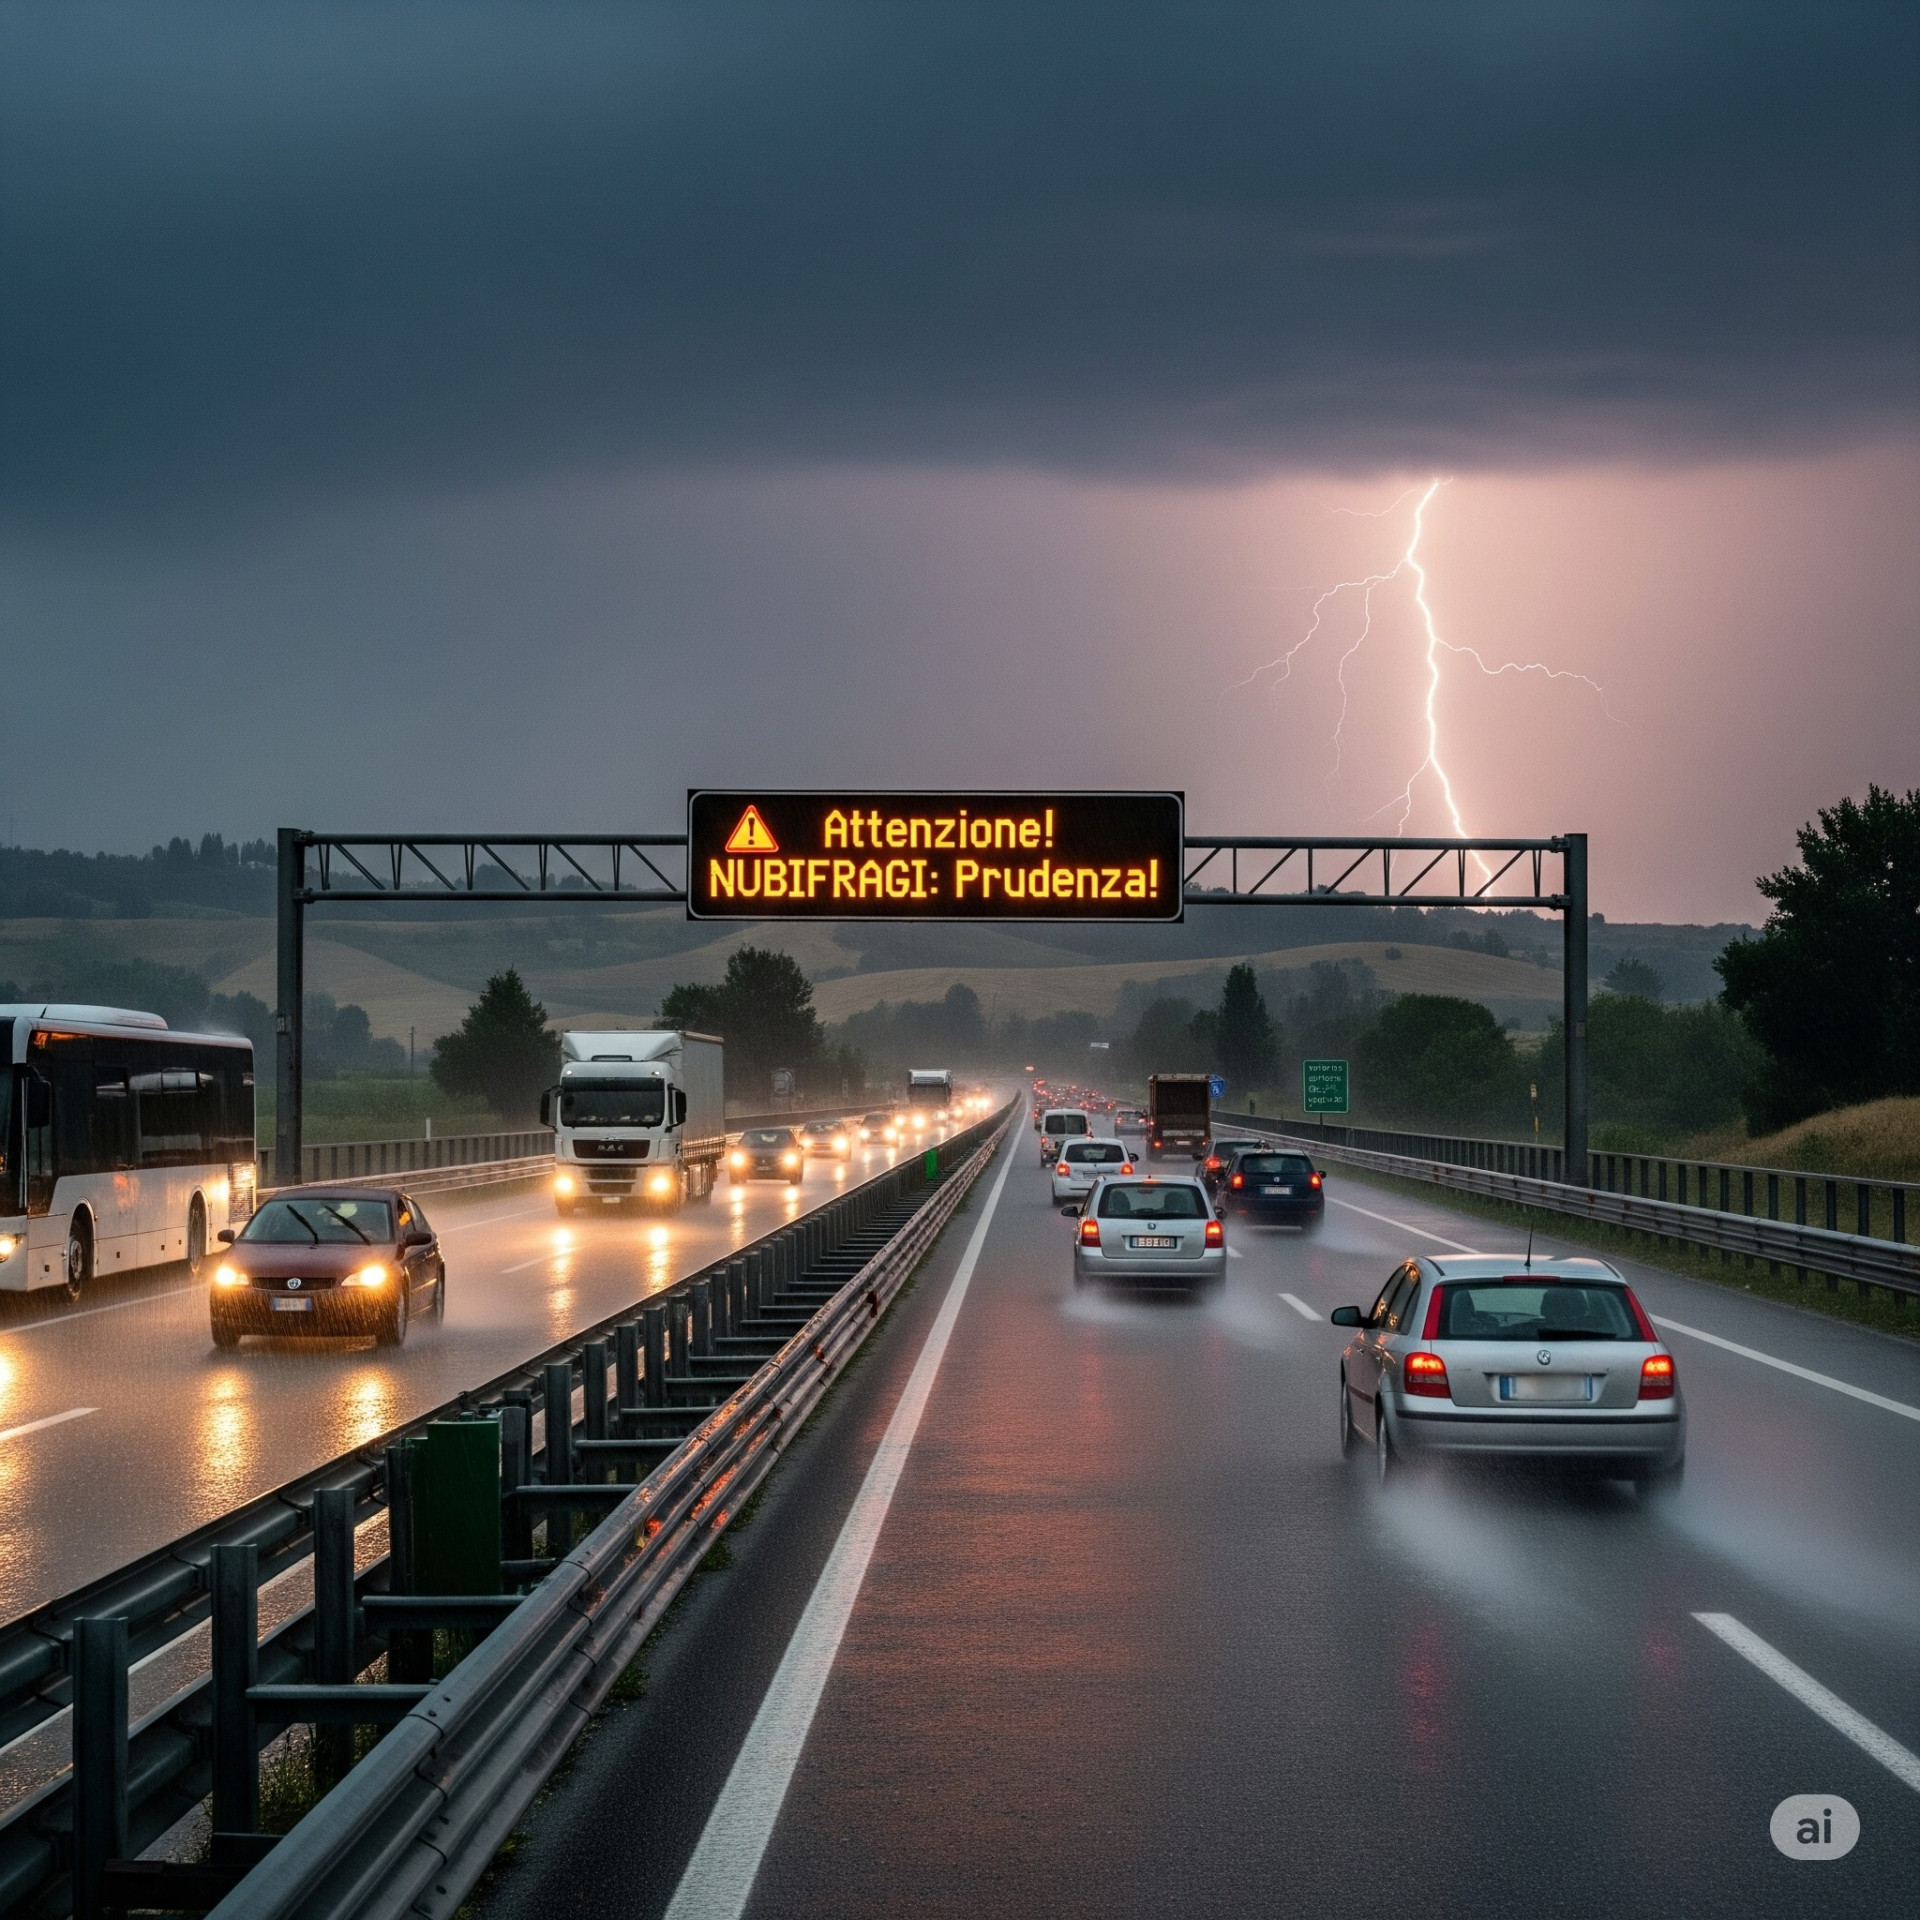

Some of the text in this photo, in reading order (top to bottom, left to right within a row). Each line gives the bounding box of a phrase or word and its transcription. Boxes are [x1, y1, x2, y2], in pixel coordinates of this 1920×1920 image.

[824, 809, 1054, 849] Attenzione!
[709, 858, 1159, 899] NUBIFRAGI: Prudenza!
